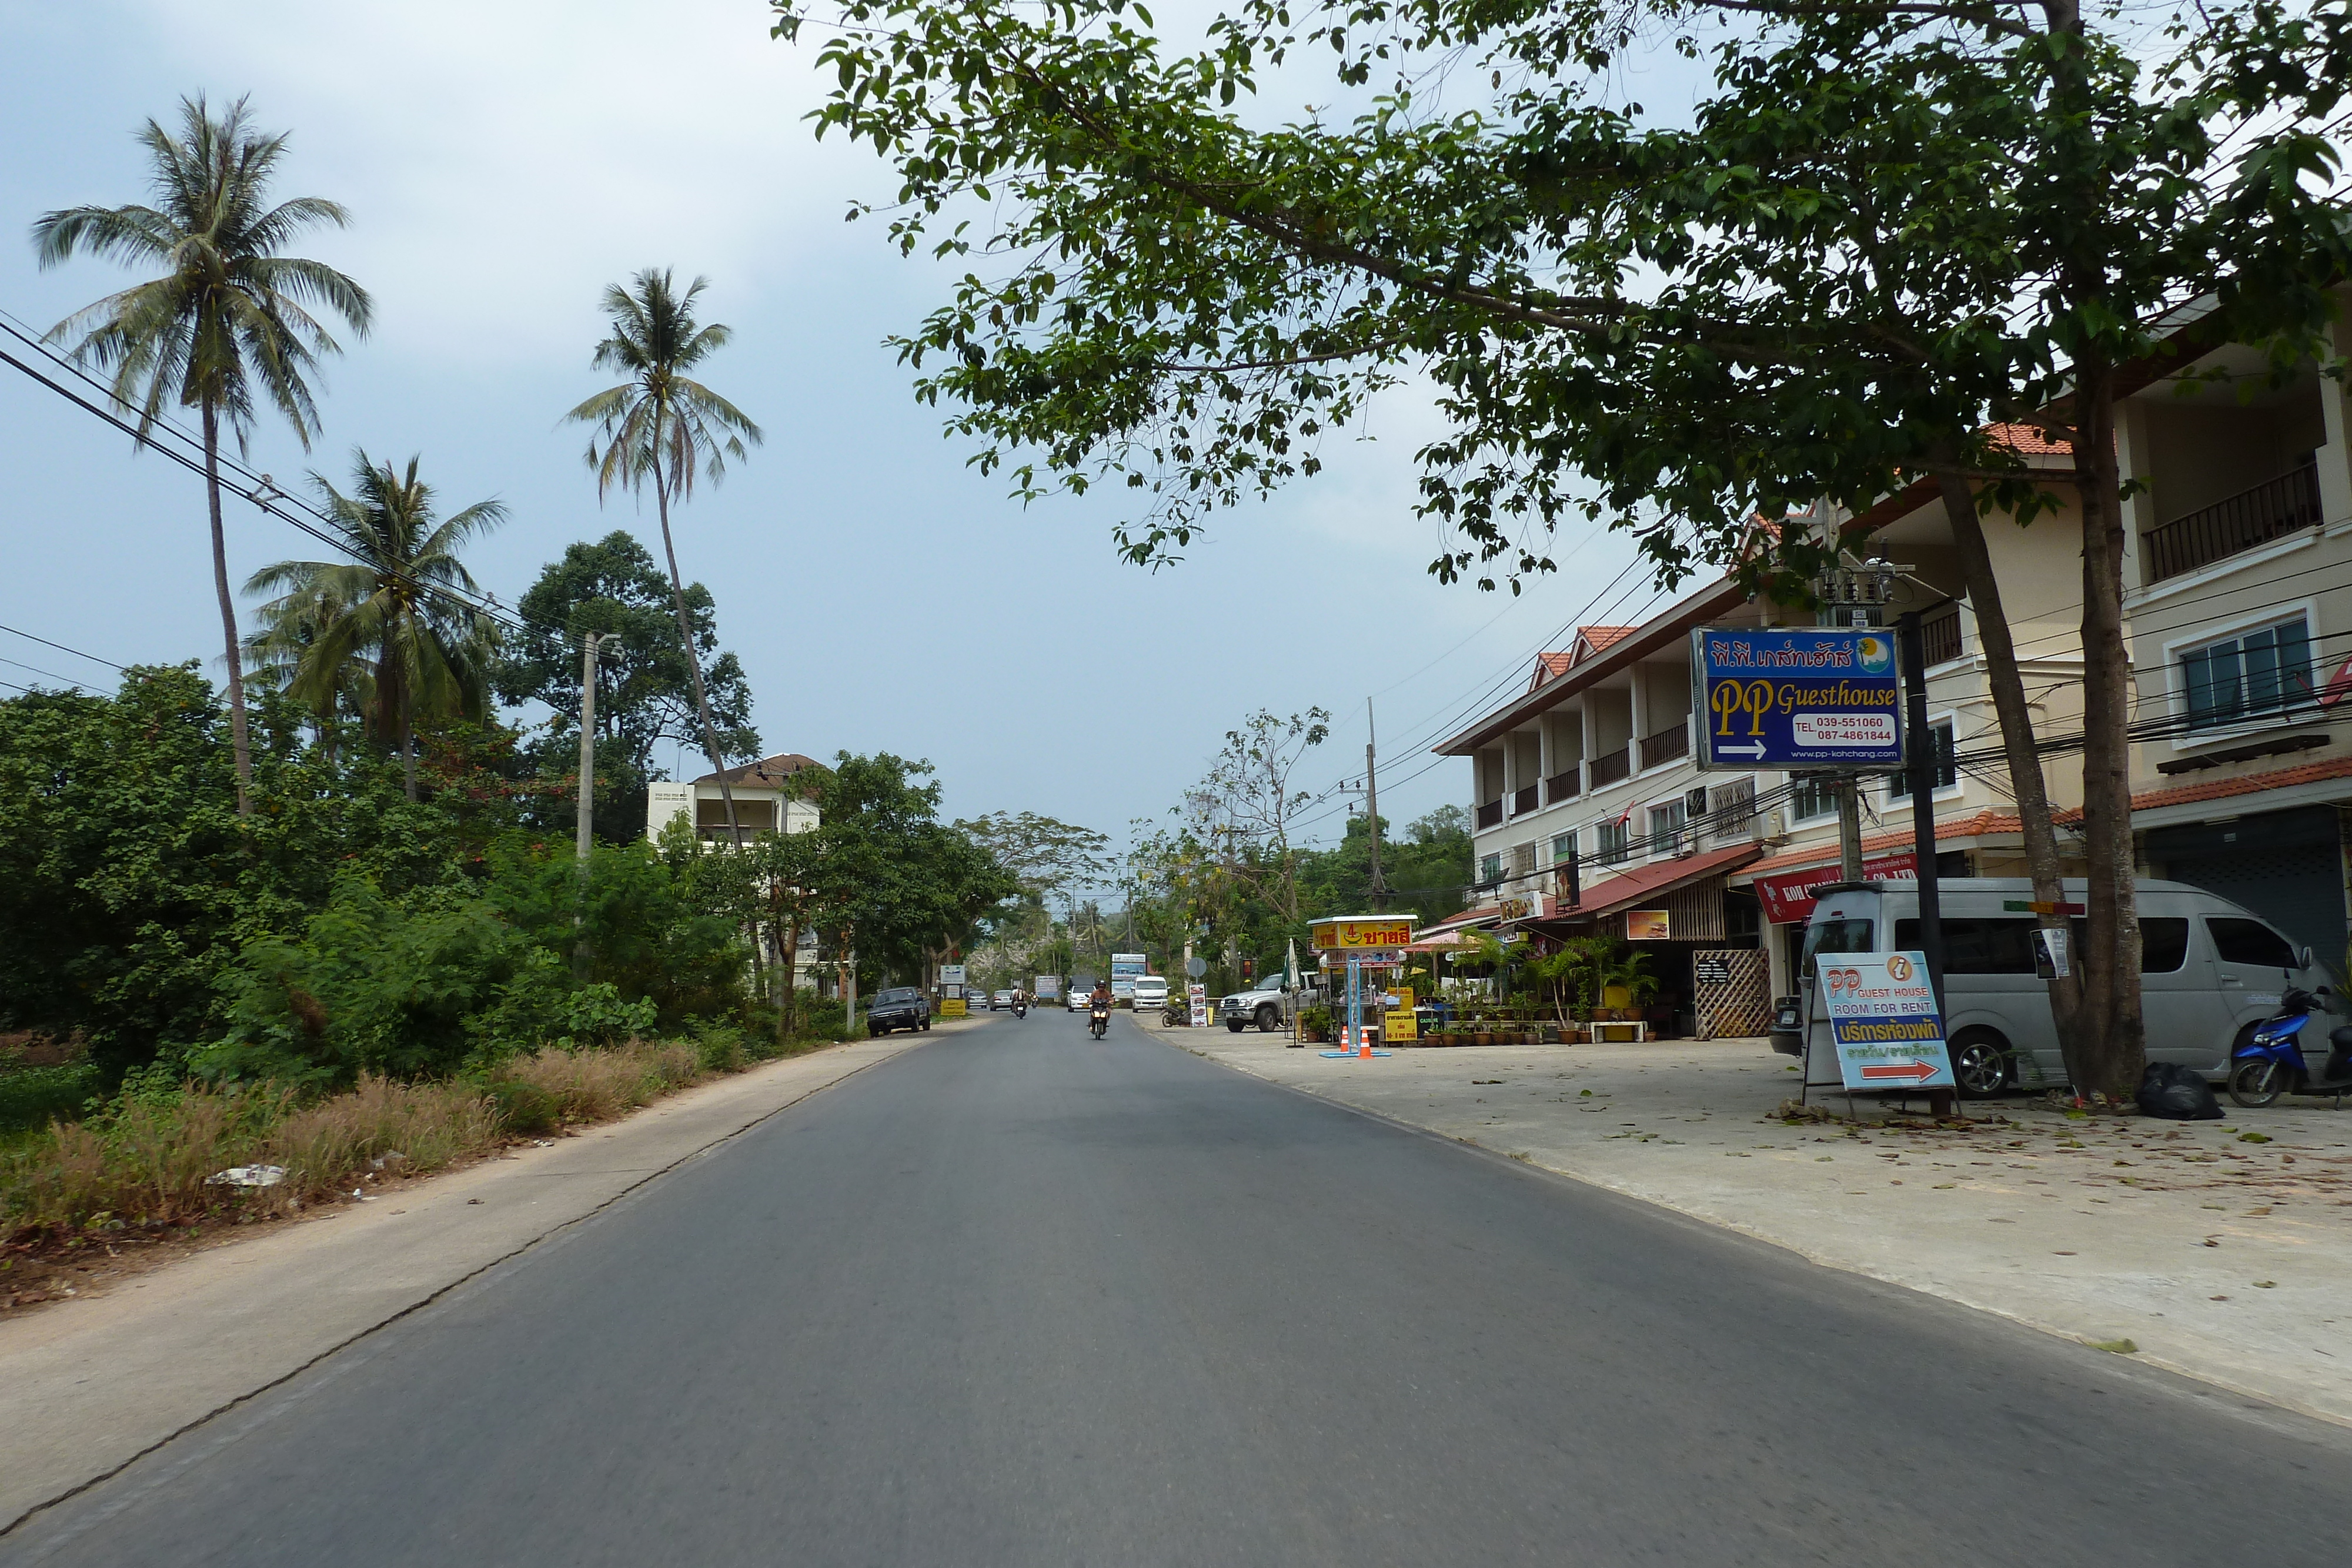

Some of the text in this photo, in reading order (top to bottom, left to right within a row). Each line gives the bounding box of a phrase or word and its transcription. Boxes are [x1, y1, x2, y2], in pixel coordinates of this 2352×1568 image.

[1712, 679, 1895, 736] PP Guesthouse
[1817, 717, 1883, 727] 039-551060
[1795, 723, 1816, 733] TEL.
[1818, 731, 1890, 740] 087-4861844
[1791, 750, 1897, 760] www.pp-kohchang.com
[1782, 885, 1805, 901] KOH
[1858, 987, 1929, 998] GUEST HOUSE
[1834, 1002, 1931, 1015] ROOM FOR RENT
